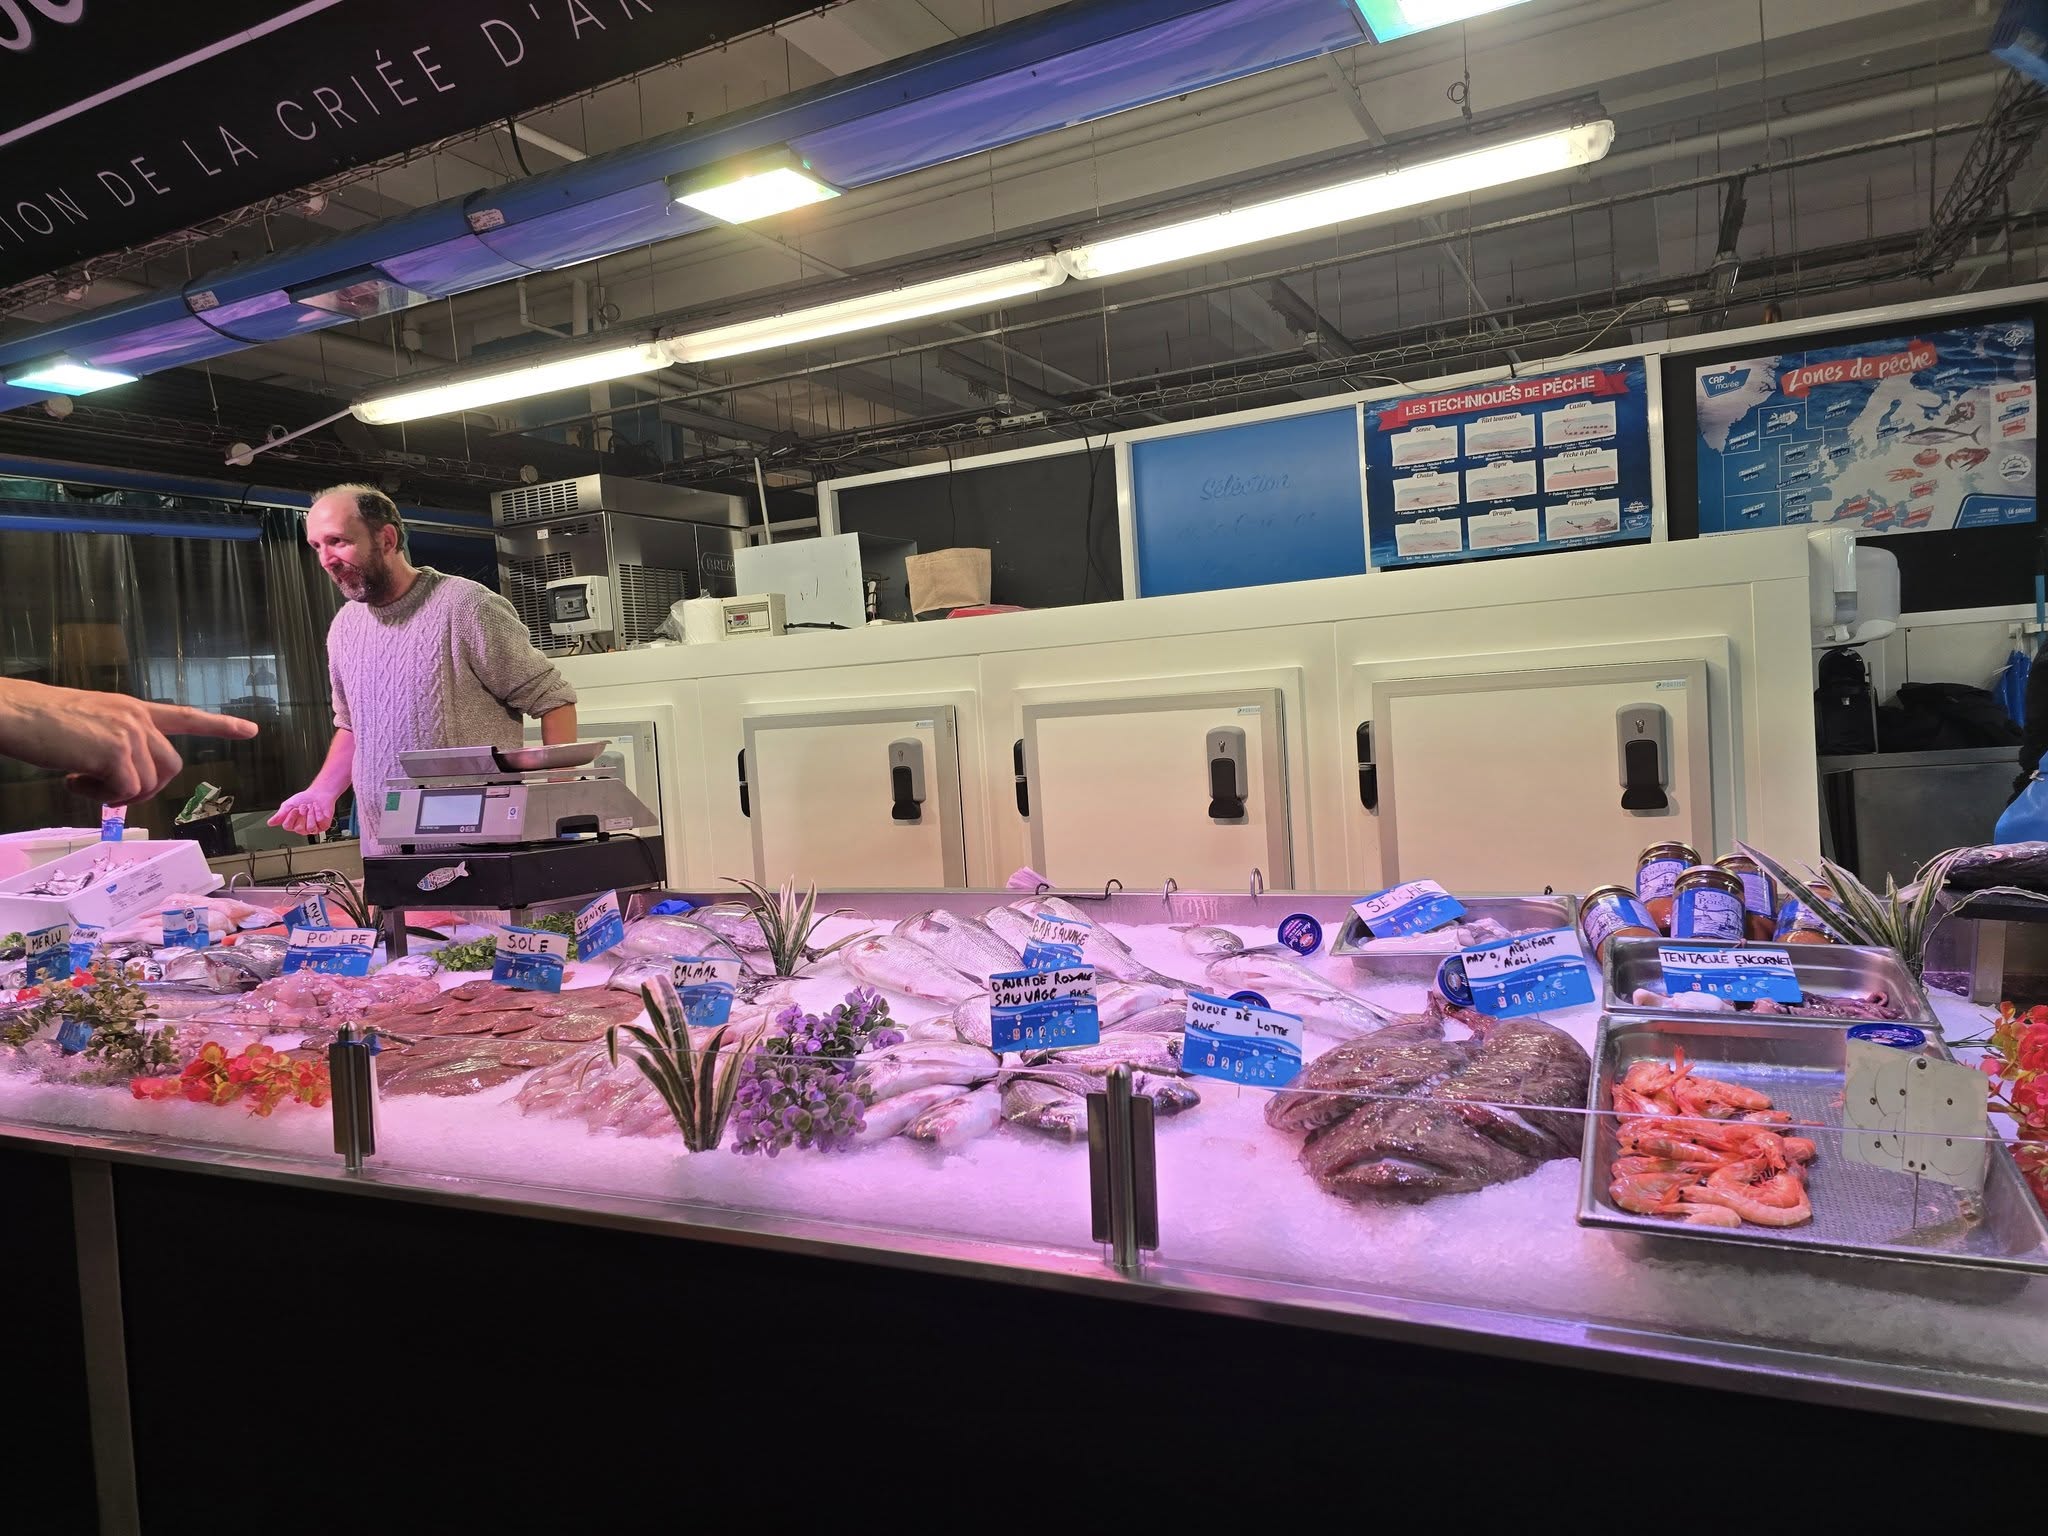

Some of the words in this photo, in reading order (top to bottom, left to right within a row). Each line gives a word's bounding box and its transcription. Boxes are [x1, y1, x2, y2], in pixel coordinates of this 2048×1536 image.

[0, 187, 89, 251] ION
[97, 156, 171, 207] DE
[182, 125, 258, 177] LA
[276, 46, 456, 141] CRIÉE
[1708, 375, 1725, 385] CAP
[1787, 365, 1843, 392] Zones
[1850, 357, 1872, 379] de
[1879, 351, 1932, 380] pêche
[1715, 380, 1740, 390] marée
[1405, 404, 1427, 417] LES
[1428, 387, 1522, 413] TECHNIQUES
[1525, 387, 1540, 398] DE
[1542, 375, 1595, 397] PÊCHE
[1366, 883, 1429, 913] SEIHE
[1032, 919, 1051, 938] BAR
[32, 930, 62, 950] MERLU
[507, 934, 549, 953] SOLE
[1660, 951, 1730, 965] TENTACULE
[1734, 954, 1790, 966] ENCORNET
[674, 964, 718, 979] CALMAR
[992, 974, 1048, 992] DAURADE
[995, 987, 1057, 1007] SAUVAGE
[1191, 1001, 1228, 1016] QUEUE
[1235, 1011, 1252, 1021] DE
[1257, 1018, 1289, 1036] LOTTE
